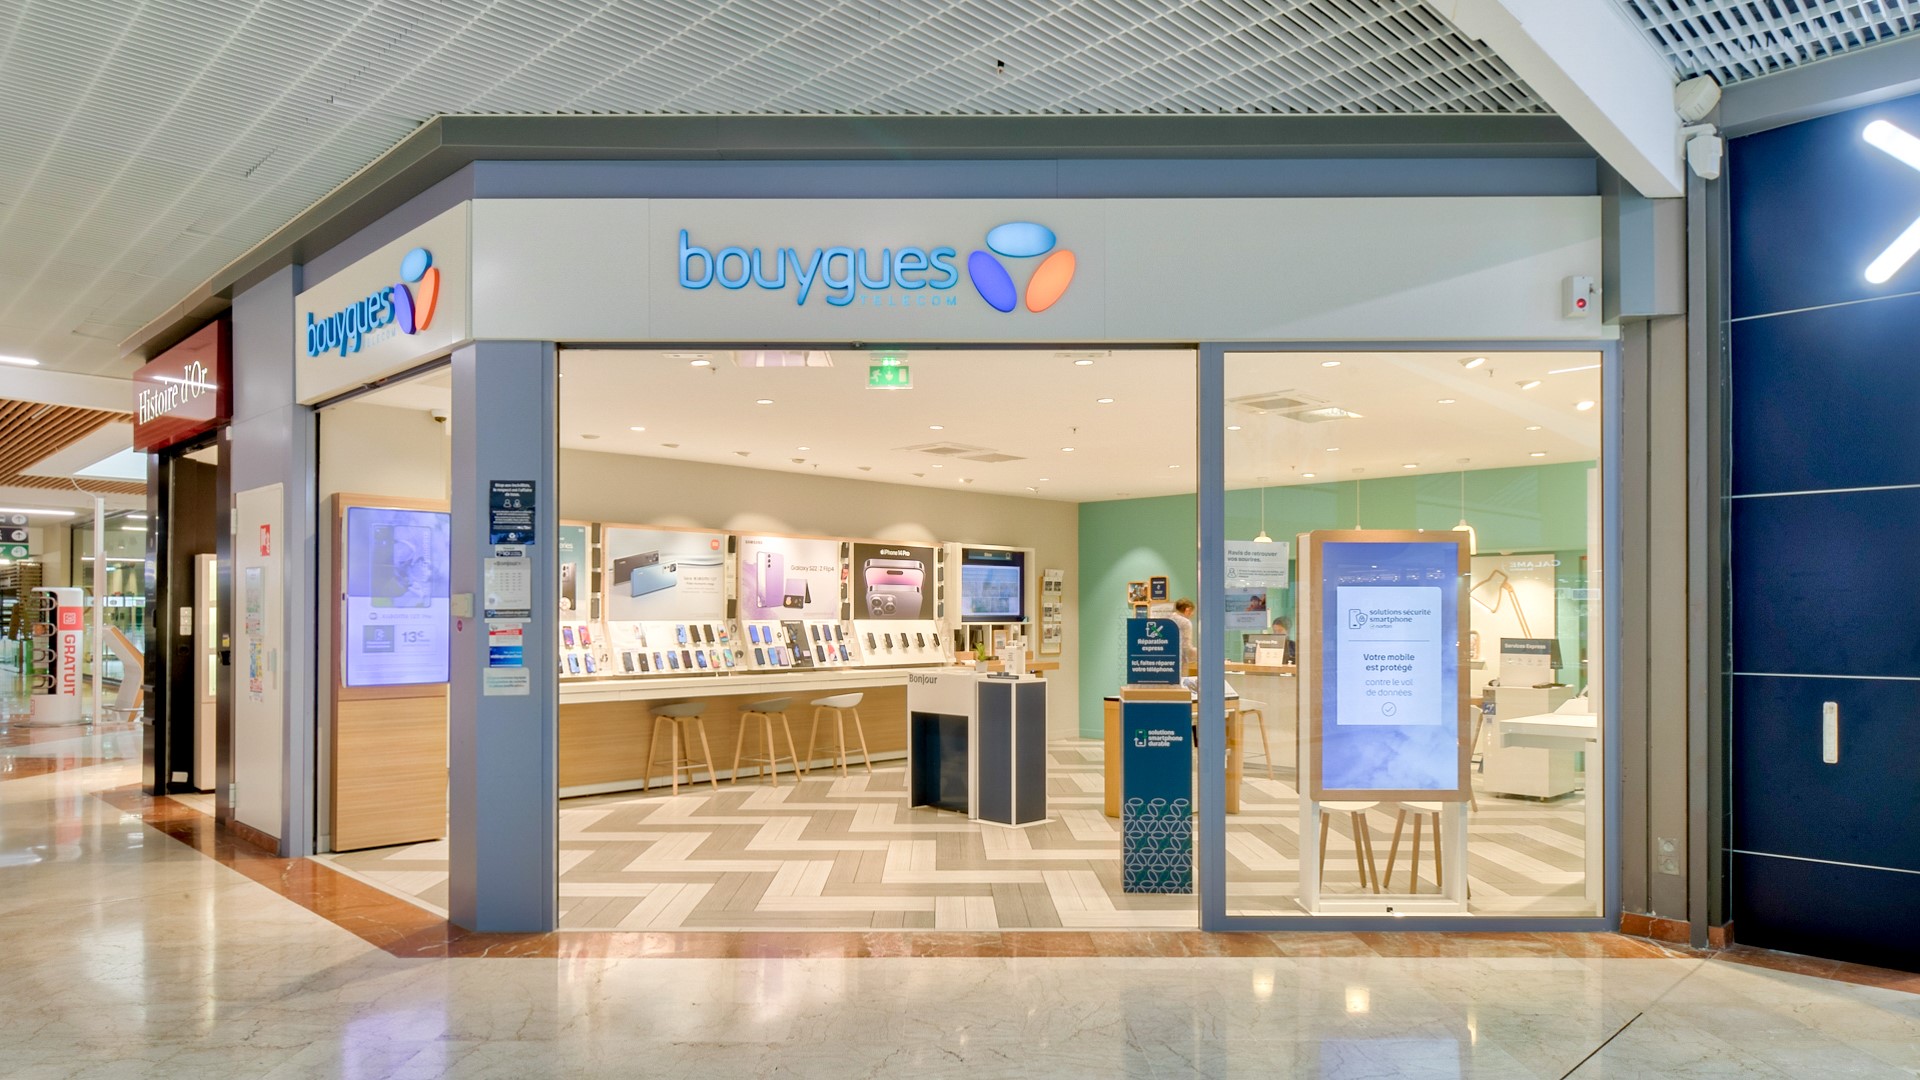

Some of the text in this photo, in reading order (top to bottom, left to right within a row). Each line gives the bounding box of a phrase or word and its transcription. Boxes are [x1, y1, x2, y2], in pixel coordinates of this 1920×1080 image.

[678, 228, 959, 306] bouygues
[860, 294, 957, 306] TELECOM
[306, 286, 396, 357] bouygues
[139, 360, 208, 425] Histoire d'Or
[791, 564, 808, 572] Galaxy
[1369, 608, 1431, 616] solutions sécurité
[1369, 616, 1413, 624] smartphone
[1137, 638, 1168, 646] Réparation
[1363, 653, 1415, 661] Votre mobile
[63, 634, 76, 696] GRATUIT
[1380, 664, 1413, 673] protégé
[909, 673, 938, 685] Bonjour
[1392, 678, 1400, 686] le
[1401, 678, 1414, 686] vol
[1366, 688, 1413, 696] de données
